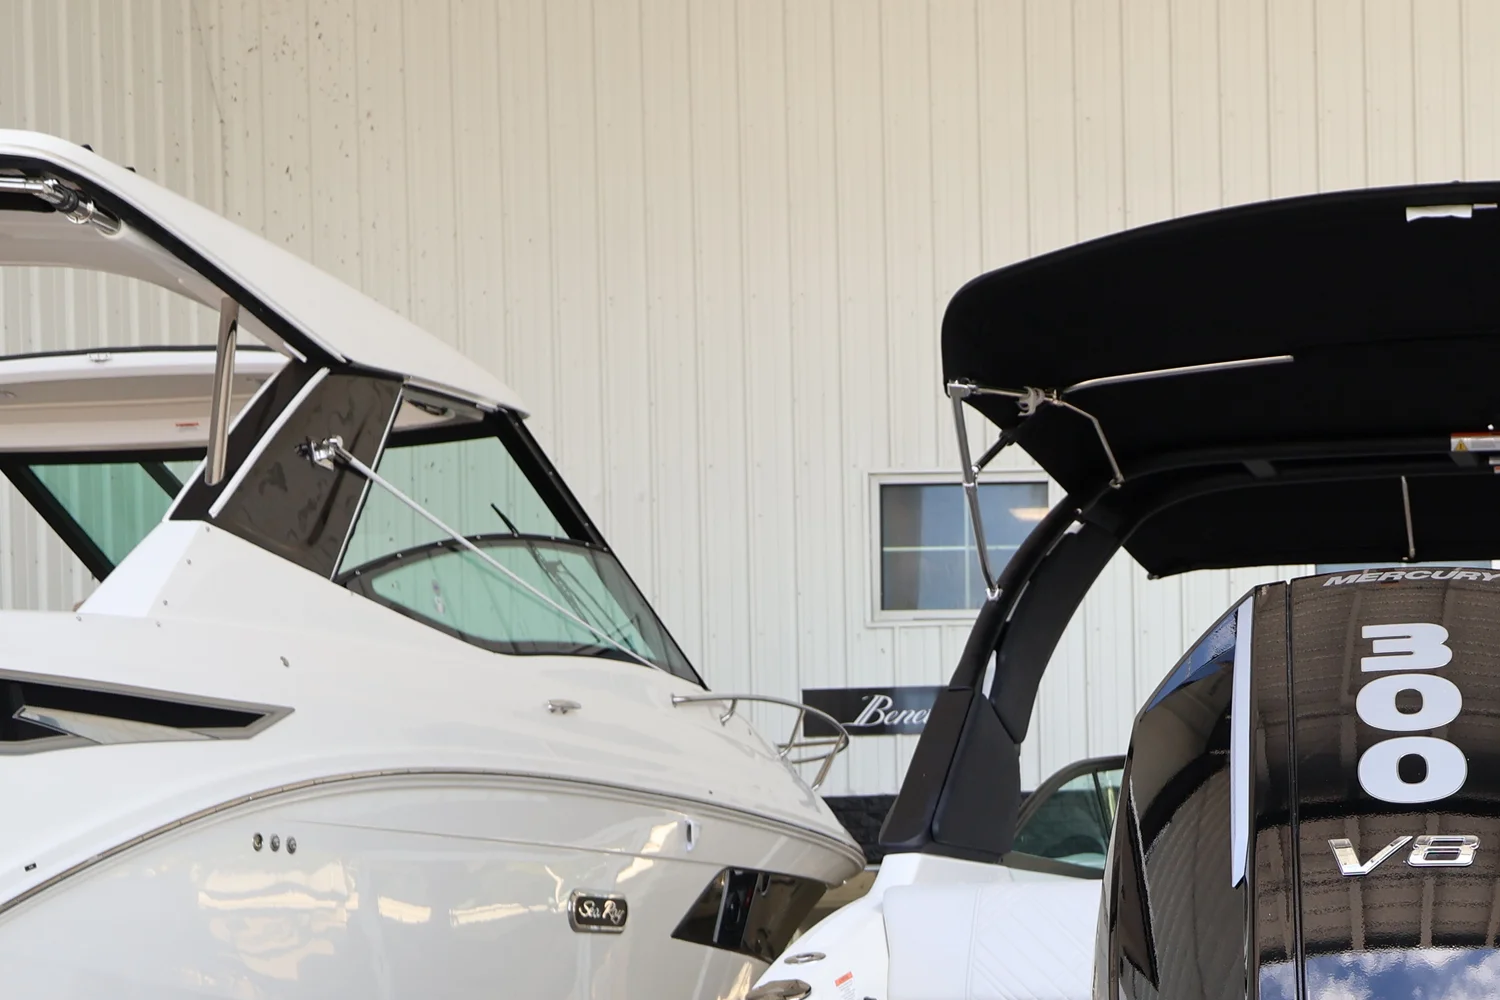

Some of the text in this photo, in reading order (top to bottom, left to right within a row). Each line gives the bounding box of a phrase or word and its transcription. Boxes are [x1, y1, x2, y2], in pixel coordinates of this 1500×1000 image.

[1355, 622, 1468, 804] 300
[1328, 835, 1481, 876] V8
[578, 900, 625, 925] Sea Ray
